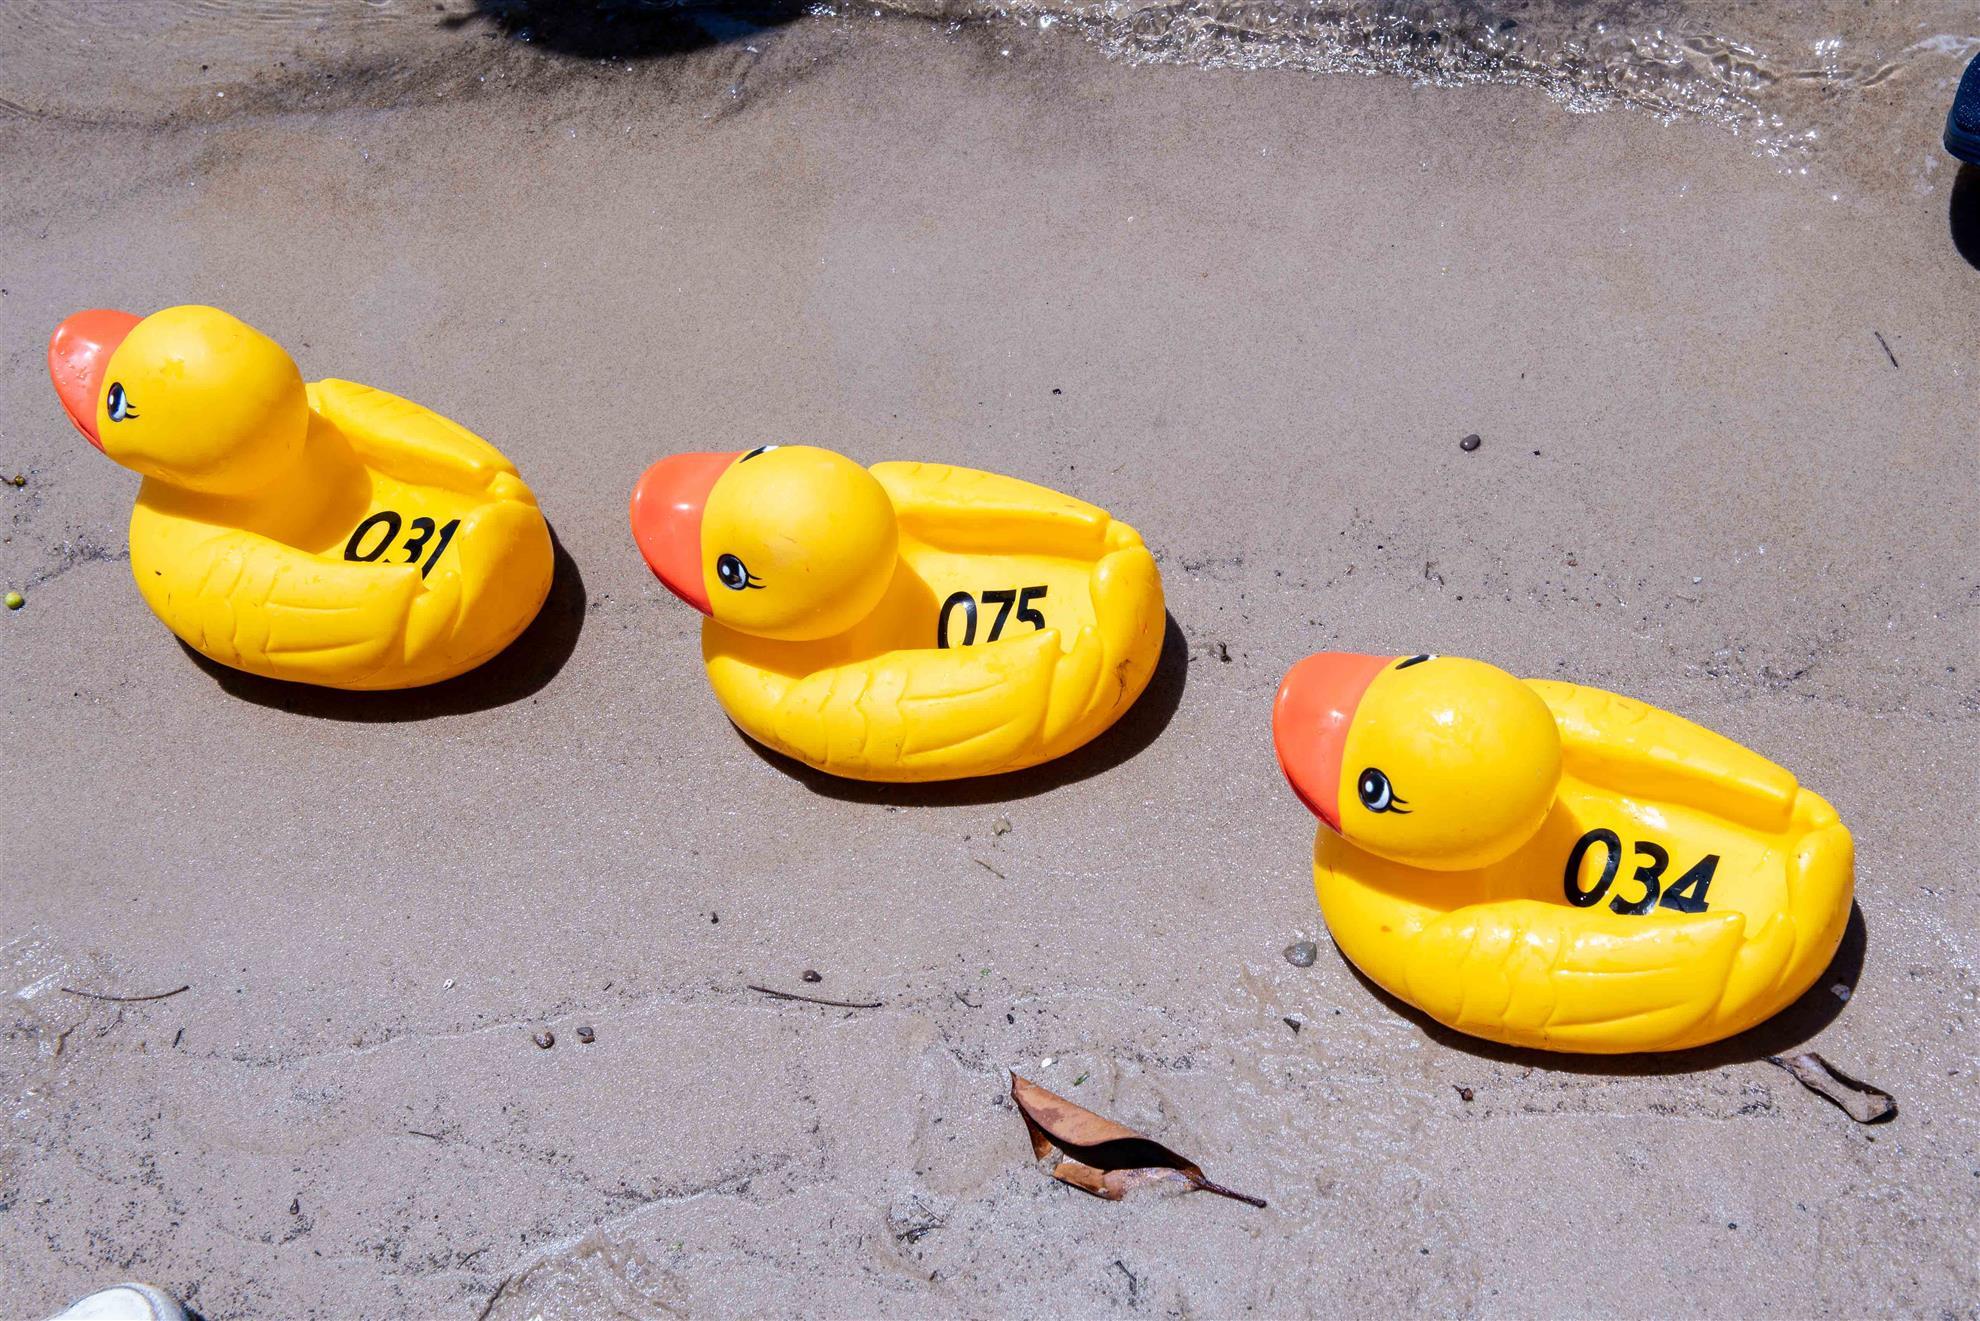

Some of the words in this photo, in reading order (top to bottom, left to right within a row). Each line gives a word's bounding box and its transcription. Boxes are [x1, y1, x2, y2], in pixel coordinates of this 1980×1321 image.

[344, 510, 461, 580] 031
[937, 585, 1048, 649] 075
[1563, 828, 1720, 916] 034
